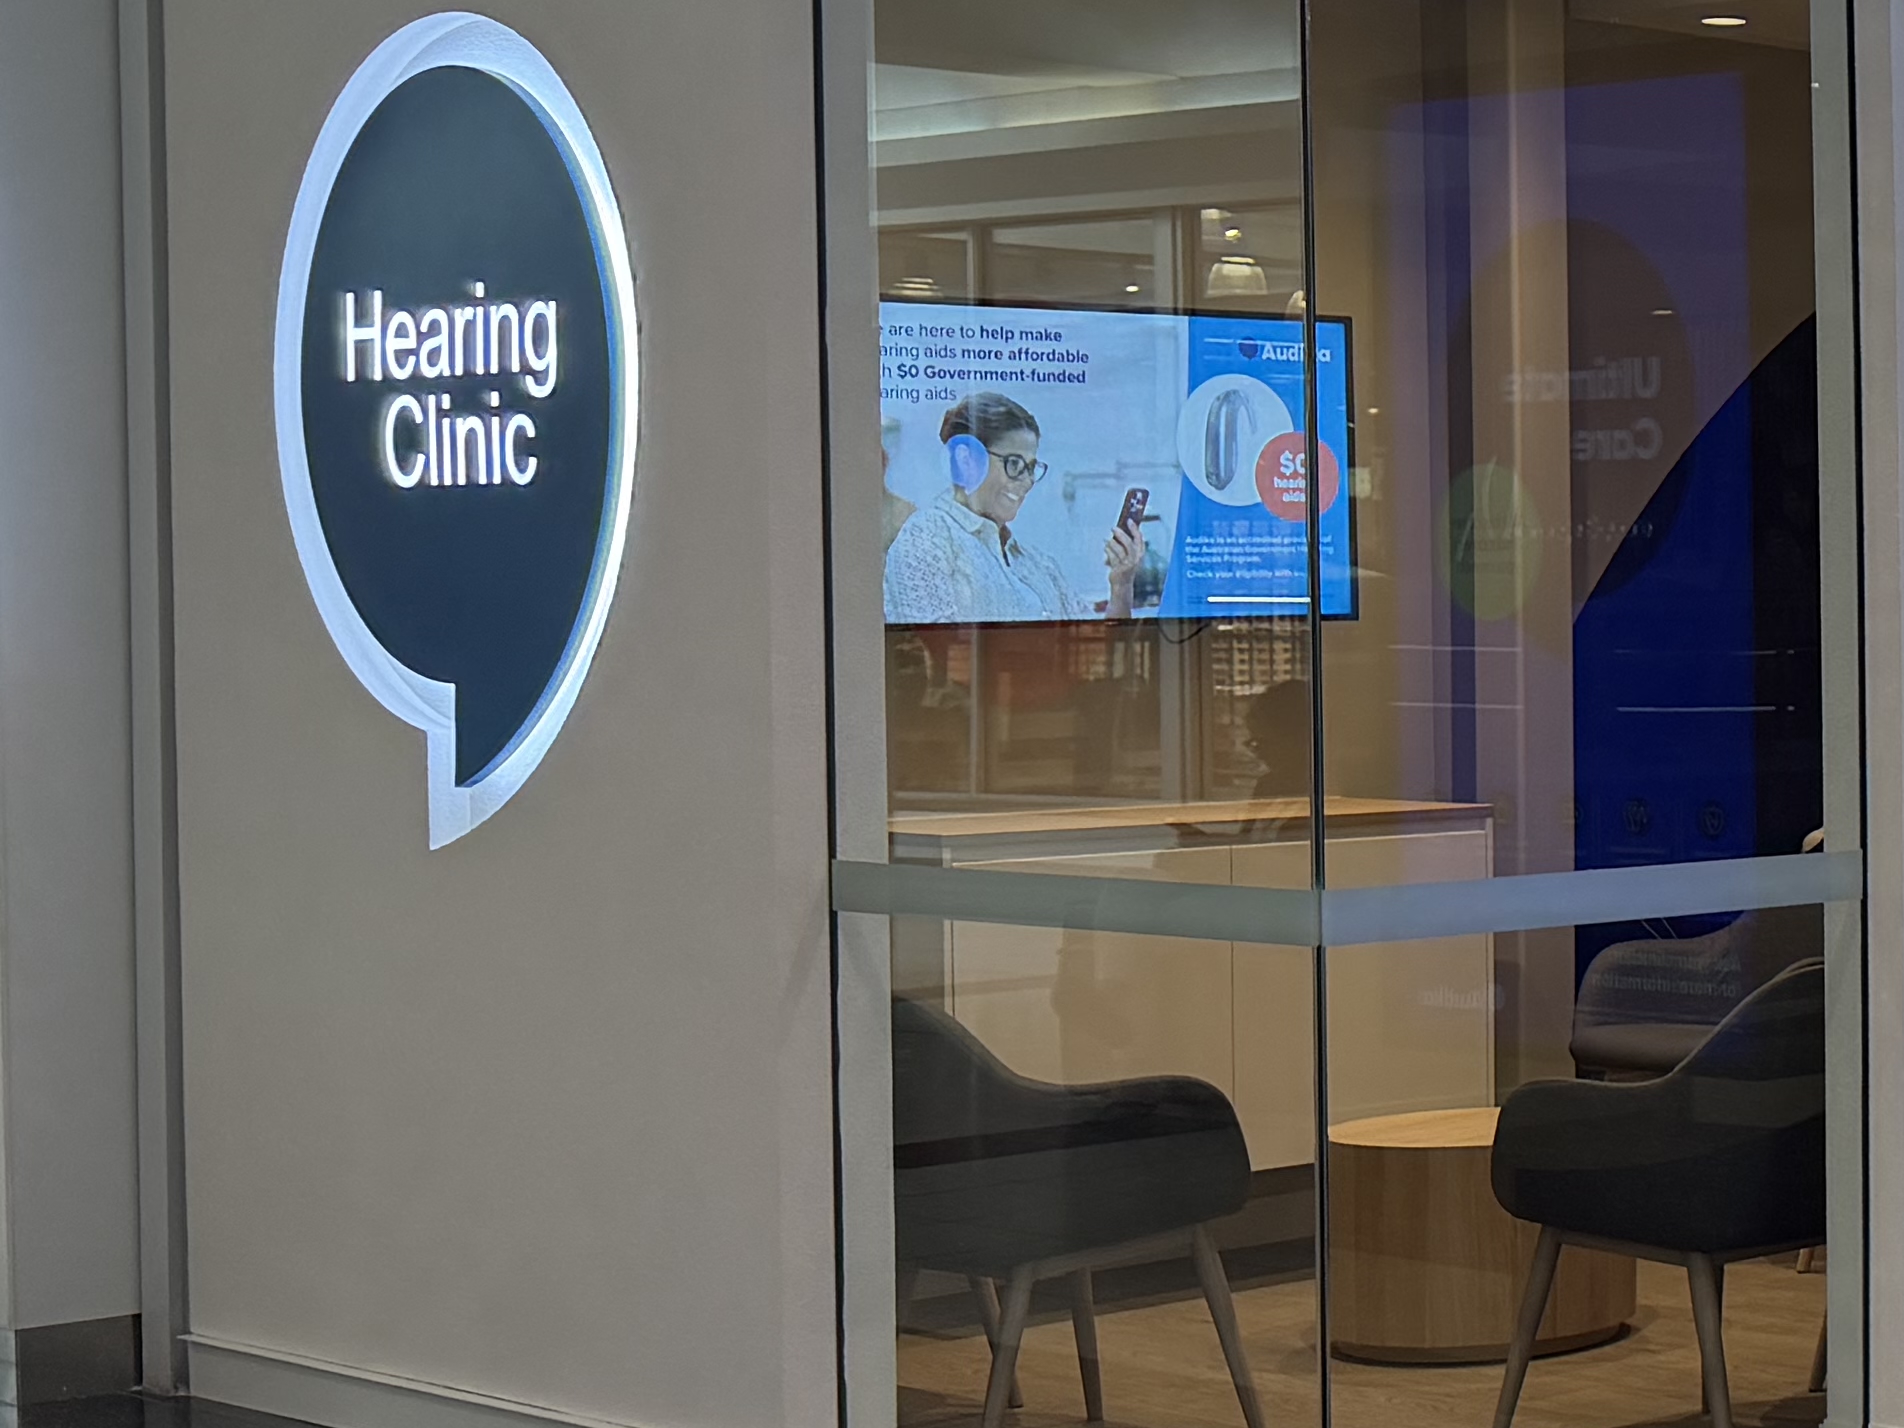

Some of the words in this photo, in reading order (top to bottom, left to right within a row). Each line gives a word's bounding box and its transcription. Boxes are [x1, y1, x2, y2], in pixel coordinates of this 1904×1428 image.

[345, 281, 558, 399] Hearing
[888, 325, 914, 337] are
[919, 324, 956, 339] here
[960, 326, 976, 339] to
[980, 326, 1015, 343] help
[1019, 328, 1063, 343] make
[879, 345, 920, 360] aring
[924, 345, 957, 360] aids
[961, 348, 1004, 361] more
[1008, 348, 1090, 364] affordable
[1261, 343, 1331, 363] Audia
[896, 364, 920, 381] $0
[924, 365, 1087, 384] Government-funded
[880, 387, 920, 403] aring
[925, 386, 957, 401] aids
[385, 390, 538, 489] Clinic
